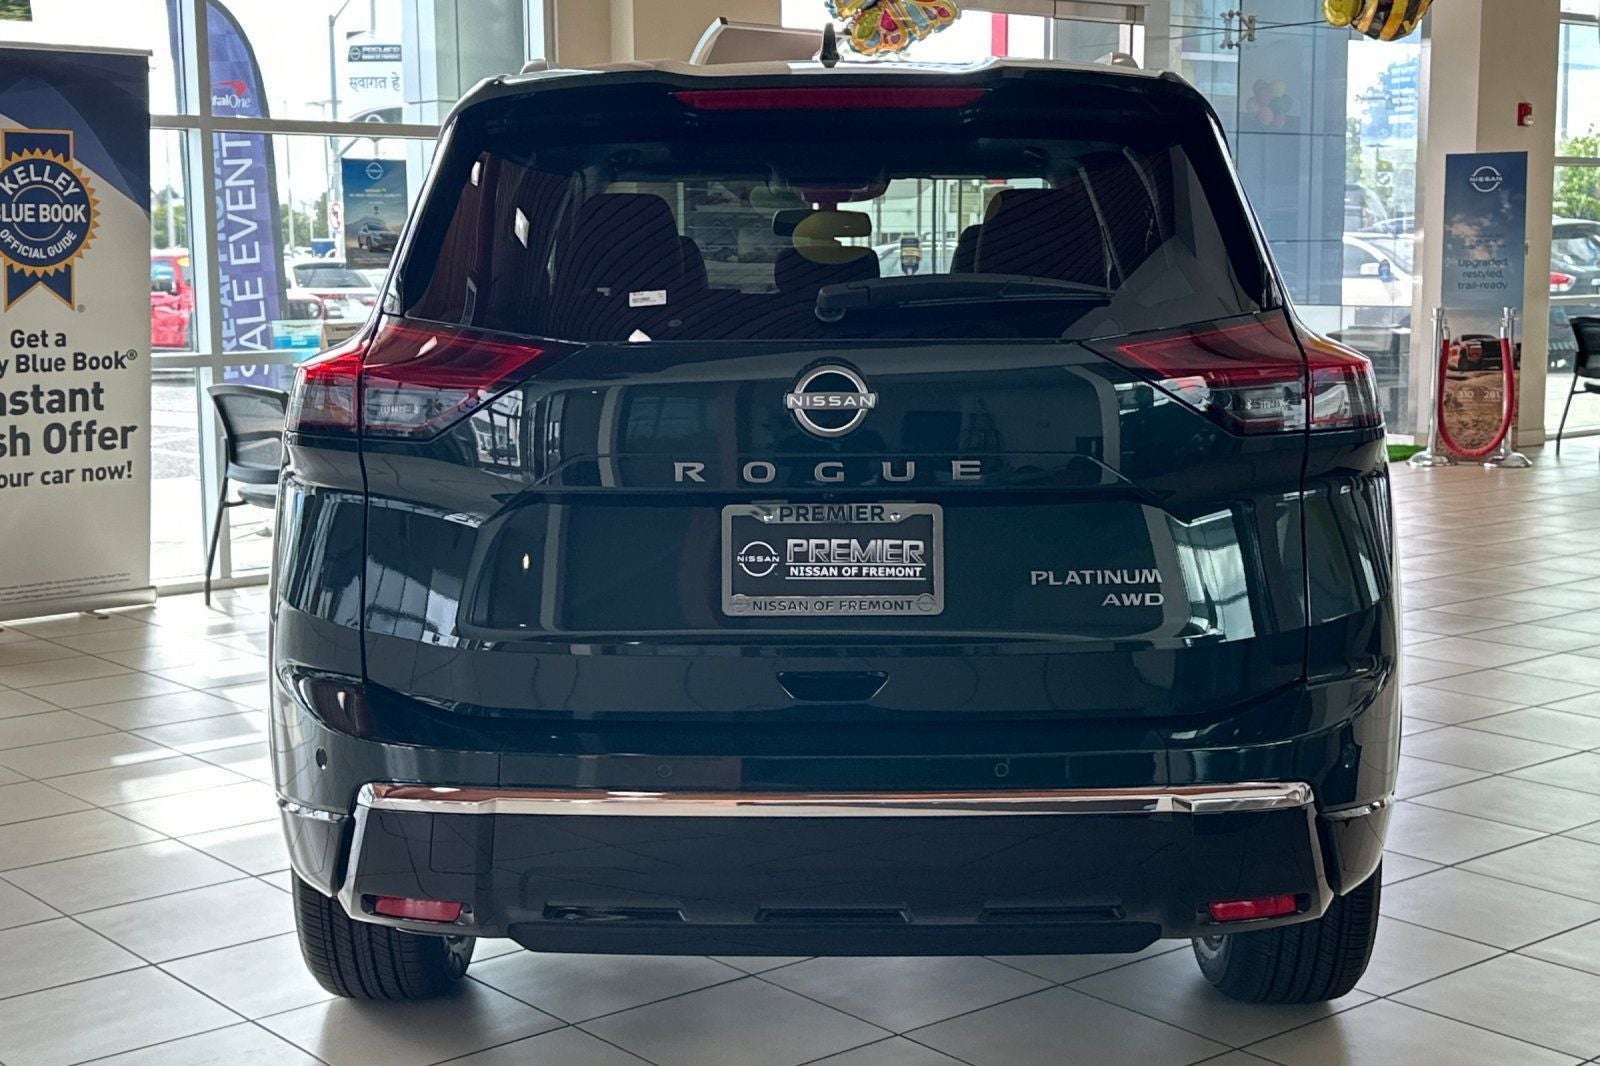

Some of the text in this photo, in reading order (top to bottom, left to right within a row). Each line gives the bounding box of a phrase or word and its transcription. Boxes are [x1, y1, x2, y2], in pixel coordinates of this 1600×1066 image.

[0, 163, 81, 197] KELLEY
[220, 132, 261, 266] EVENT
[0, 203, 87, 223] LUE BOOK
[0, 228, 78, 259] OFFICIAL GUIDE
[1457, 280, 1508, 291] trail-ready
[10, 329, 67, 348] Get a
[15, 353, 66, 373] Blue
[788, 394, 875, 407] NISSAN
[43, 420, 138, 454] Offer
[40, 468, 75, 485] car
[81, 460, 132, 482] now!
[673, 460, 982, 484] ROGUE
[778, 504, 885, 522] PREMIER
[736, 538, 926, 564] NISSAN PREMIER
[789, 566, 922, 577] NISSAN OF FREMONT
[1030, 569, 1163, 586] PLATINUM
[752, 600, 809, 611] NISSAN
[813, 600, 834, 611] OF
[839, 600, 914, 611] FREMONT
[1102, 593, 1165, 606] AWD
